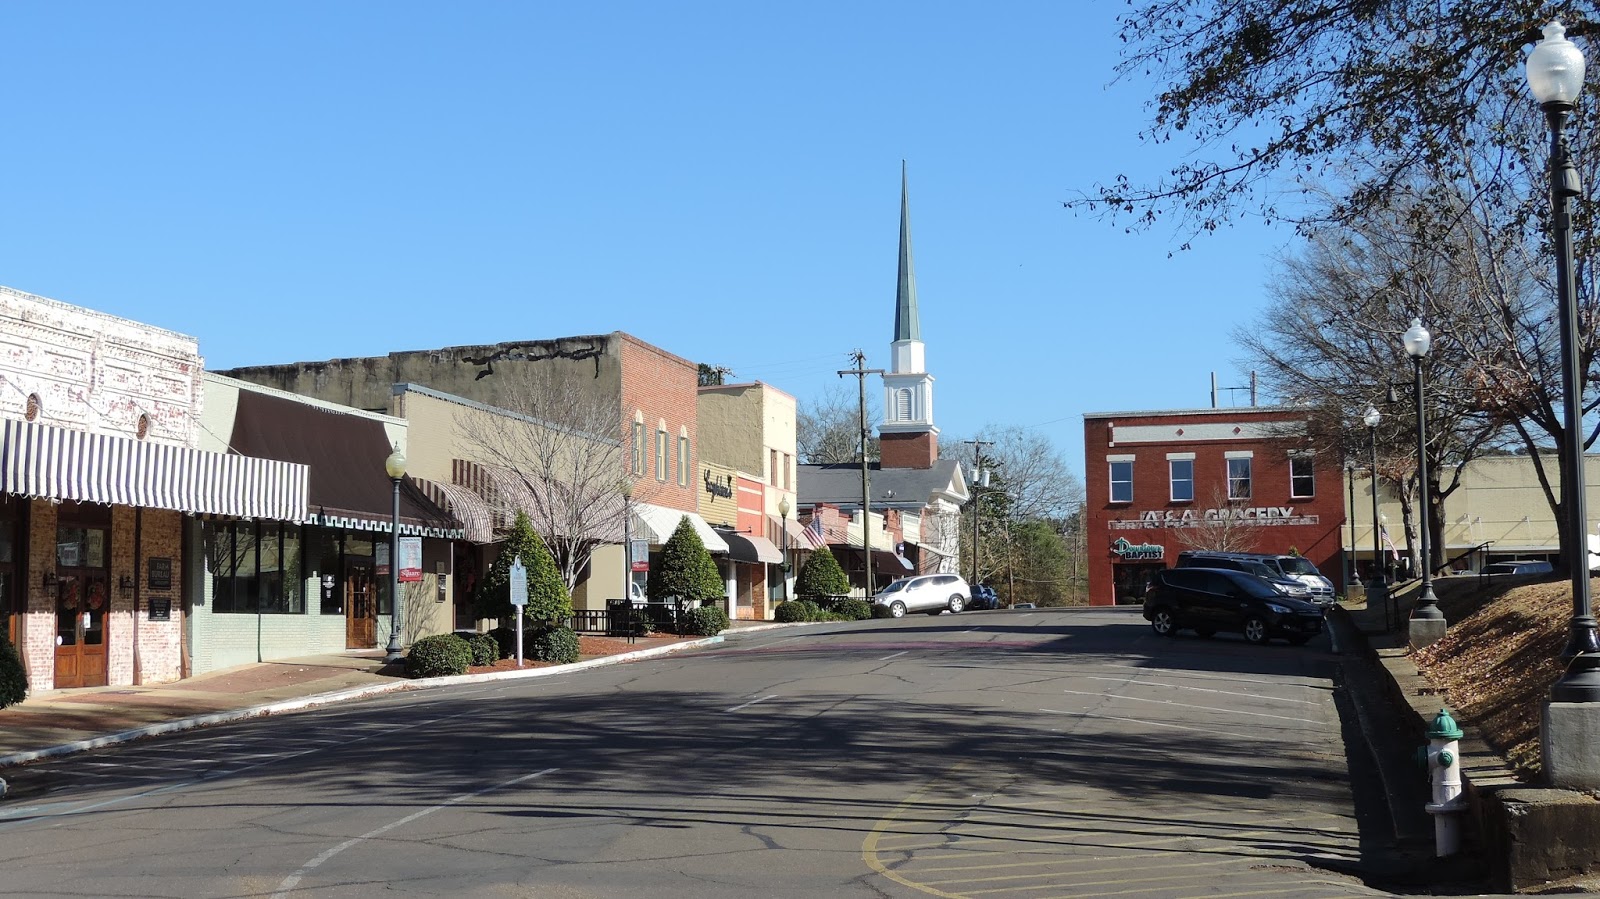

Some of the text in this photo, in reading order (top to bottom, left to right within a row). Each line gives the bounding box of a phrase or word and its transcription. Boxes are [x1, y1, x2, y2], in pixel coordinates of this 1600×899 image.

[1143, 510, 1160, 528] A
[1180, 509, 1196, 528] A
[1204, 507, 1294, 526] GROCERY
[1125, 551, 1163, 559] BAPTIST
